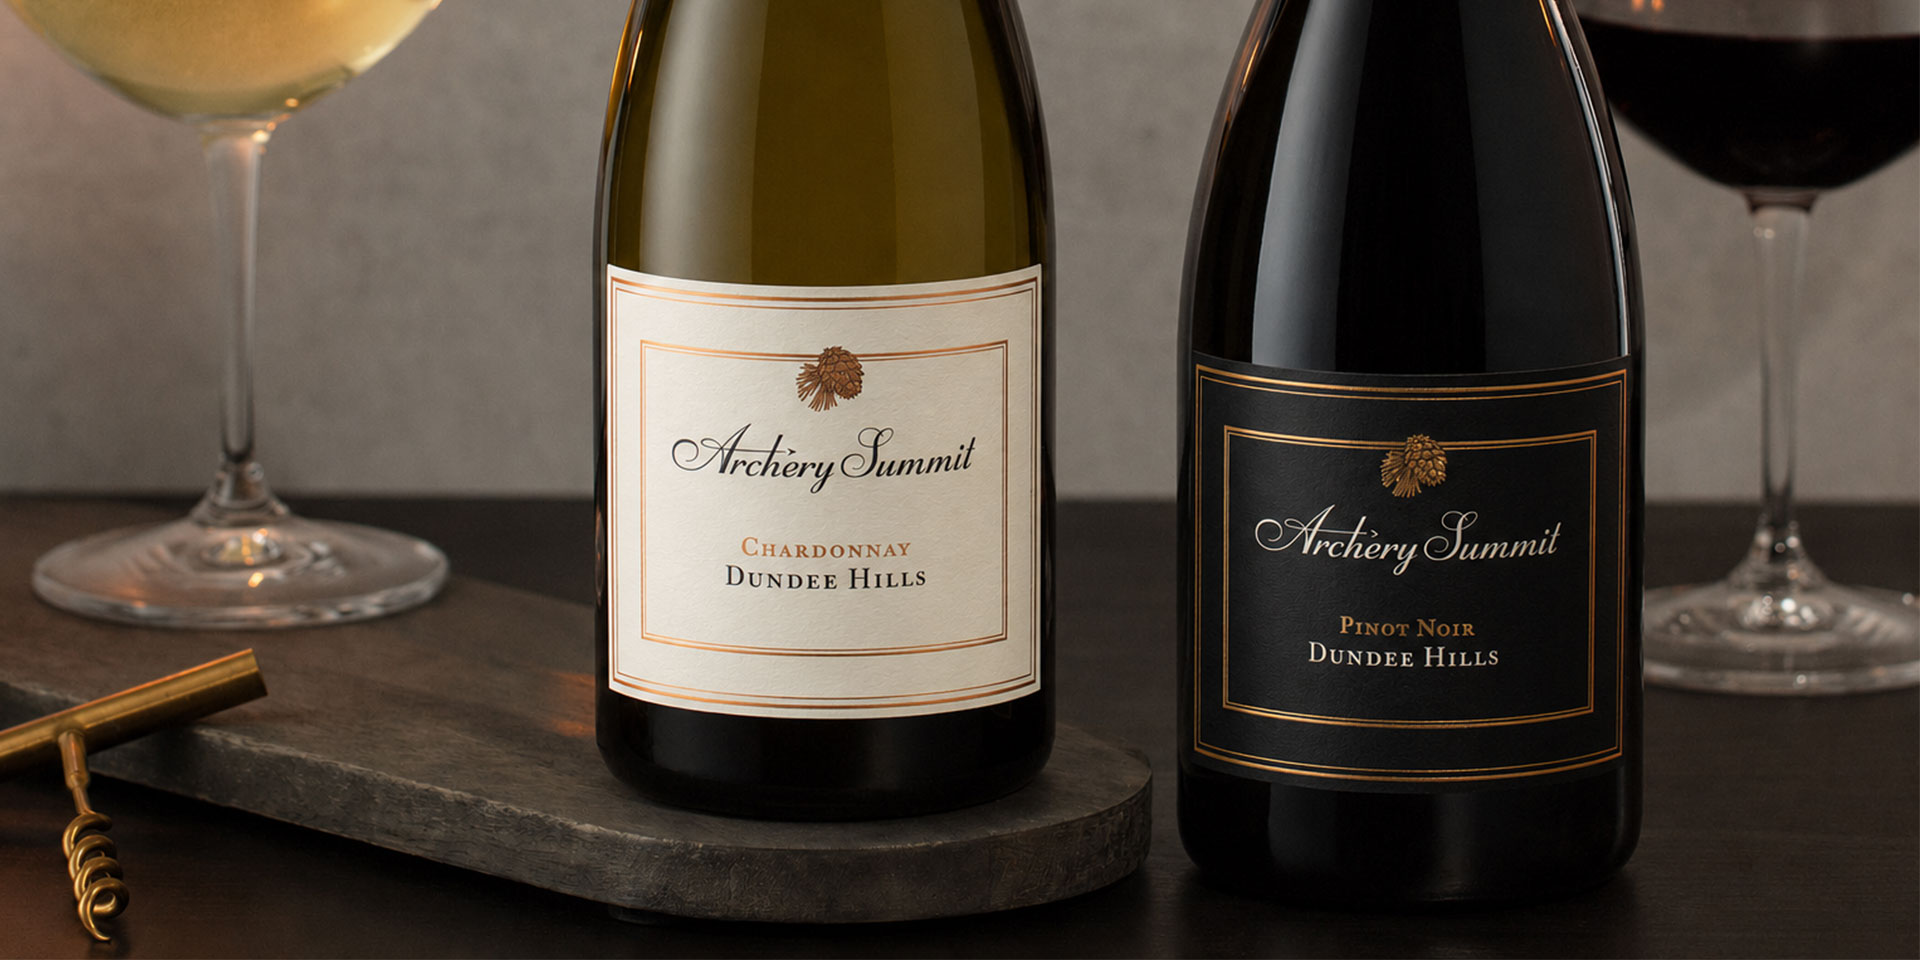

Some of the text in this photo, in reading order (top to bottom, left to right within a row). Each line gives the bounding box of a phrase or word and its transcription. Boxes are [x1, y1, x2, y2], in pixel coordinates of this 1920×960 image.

[671, 423, 977, 494] Archery Summit
[740, 536, 912, 559] CHARDONNAY
[1254, 504, 1562, 576] Archery Summit
[725, 564, 927, 590] DUNDEE HILLS
[1339, 615, 1476, 638] PINOT NOIR
[1308, 641, 1500, 668] DUNDEE HILLS
